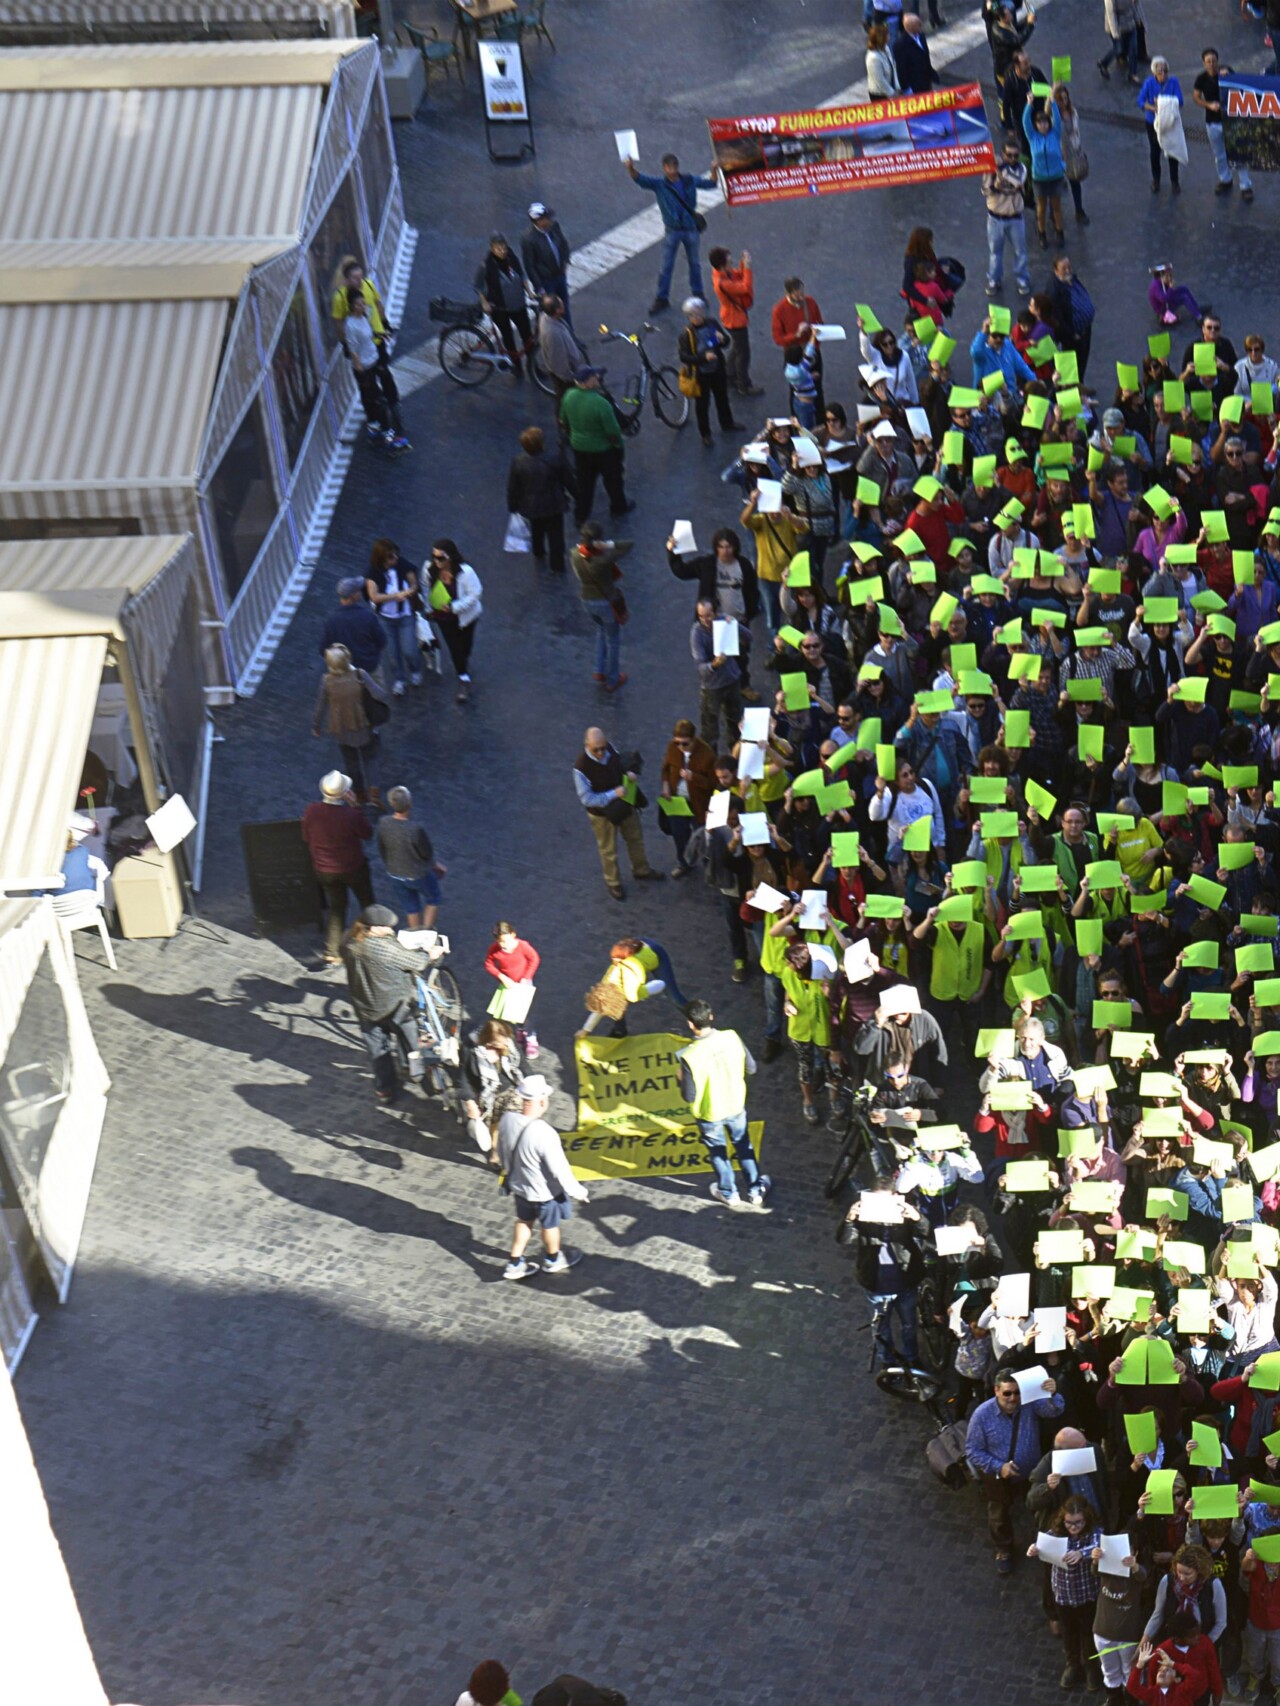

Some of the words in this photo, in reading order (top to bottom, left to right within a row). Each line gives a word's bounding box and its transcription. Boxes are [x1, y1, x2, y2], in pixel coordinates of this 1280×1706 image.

[780, 106, 883, 132] FUMIGACIONES
[887, 92, 955, 117] ILEGALES!
[581, 1057, 631, 1076] AVE
[580, 1075, 681, 1100] IMAT
[560, 1132, 705, 1152] REENPEAC
